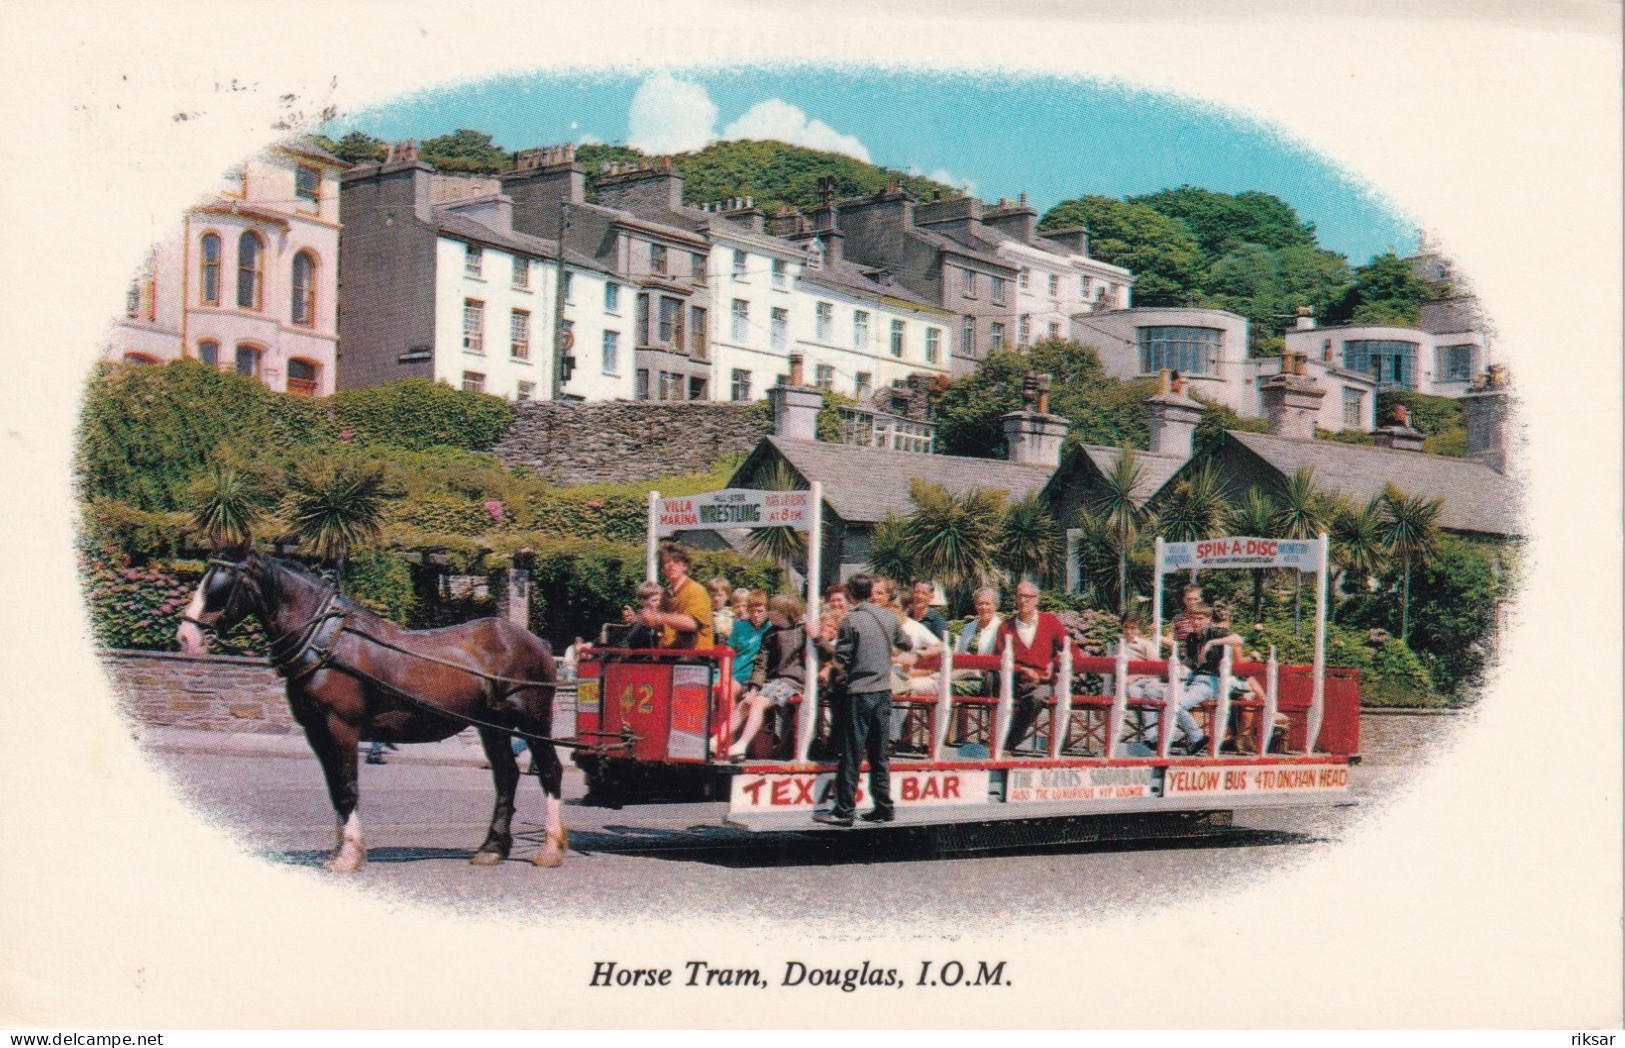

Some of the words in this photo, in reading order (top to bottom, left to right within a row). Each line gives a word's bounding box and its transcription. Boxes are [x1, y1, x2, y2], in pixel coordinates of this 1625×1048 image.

[664, 499, 692, 513] VILLA
[700, 503, 760, 523] WRESTLING
[660, 513, 698, 525] MARINA
[620, 682, 654, 714] 42
[901, 775, 961, 801] BAR
[1169, 771, 1220, 791] YELLOW
[1224, 771, 1247, 790] BUS
[1276, 769, 1316, 788] ONCHAN
[1319, 769, 1348, 787] HEAD
[589, 961, 672, 987] Horse
[685, 961, 768, 988] Tram,
[781, 960, 904, 992] Douglas,
[915, 960, 1012, 987] I.O.M.
